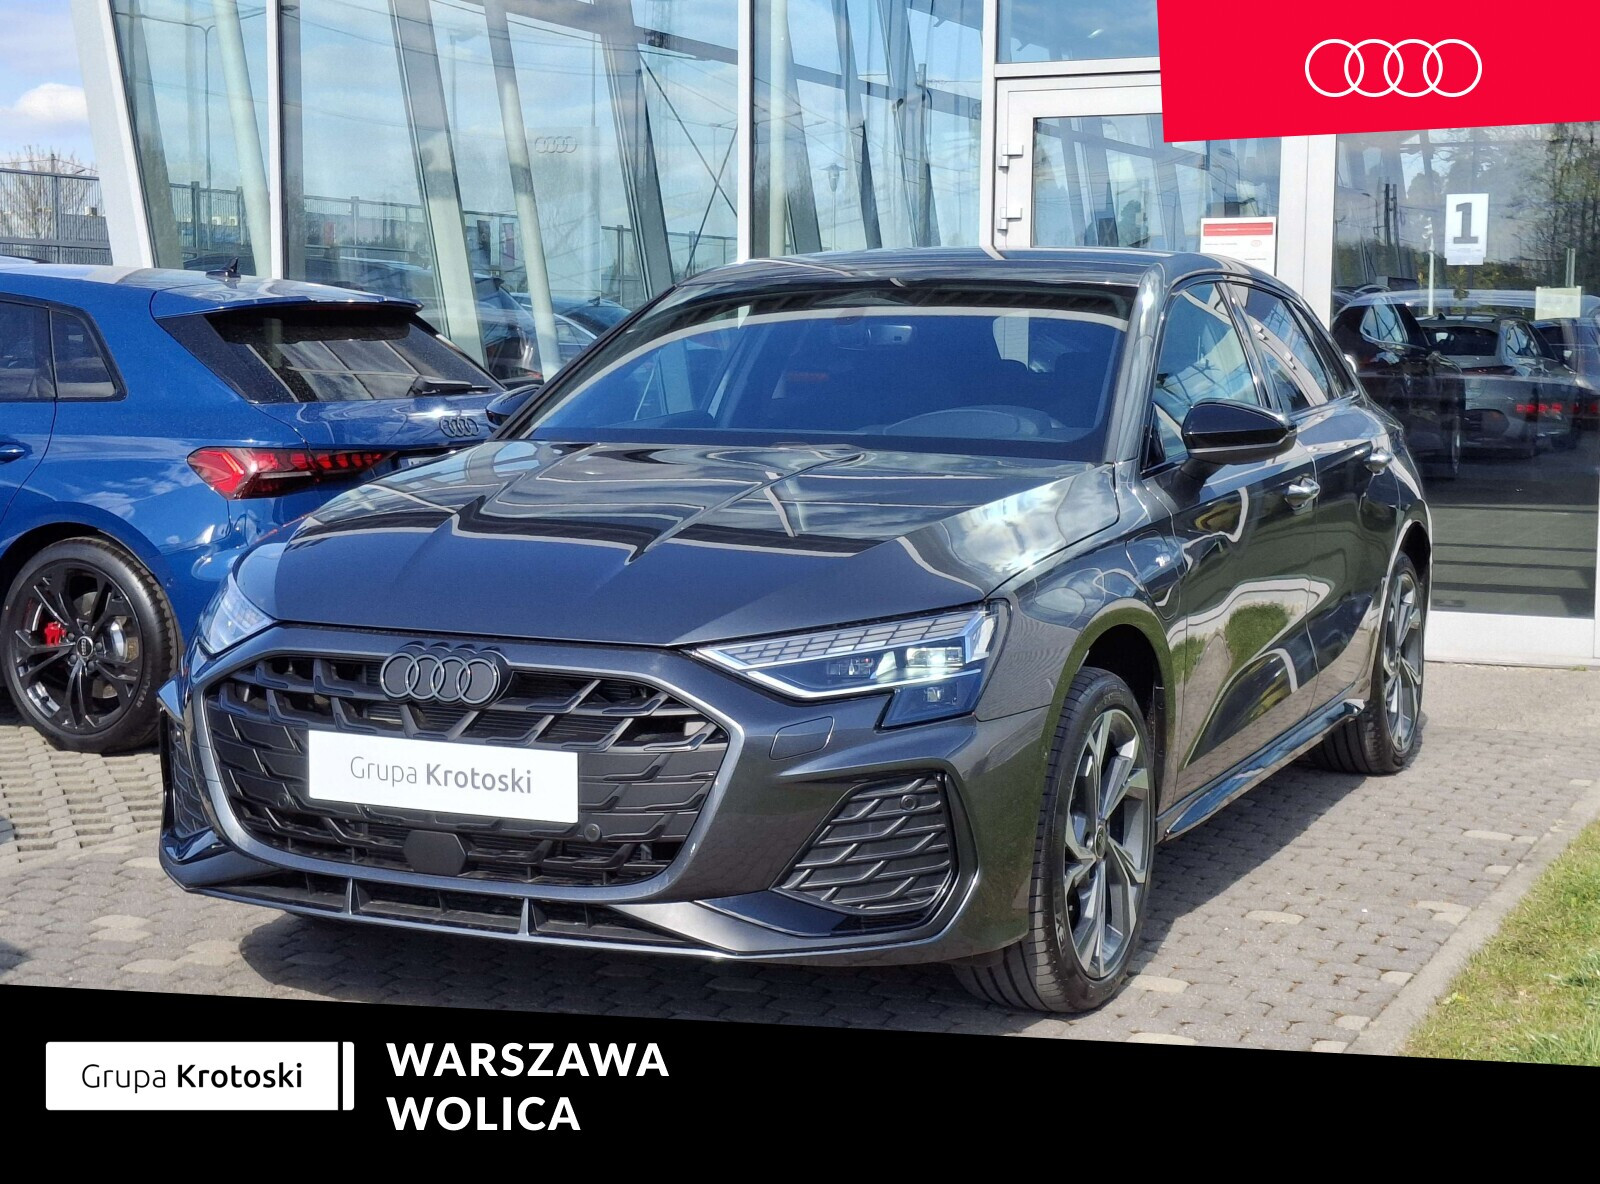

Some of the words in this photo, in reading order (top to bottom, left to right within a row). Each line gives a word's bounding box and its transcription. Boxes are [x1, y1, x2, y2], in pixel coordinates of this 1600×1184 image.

[1453, 202, 1479, 245] 1
[350, 756, 417, 787] Grupa
[426, 763, 531, 794] Krotoski
